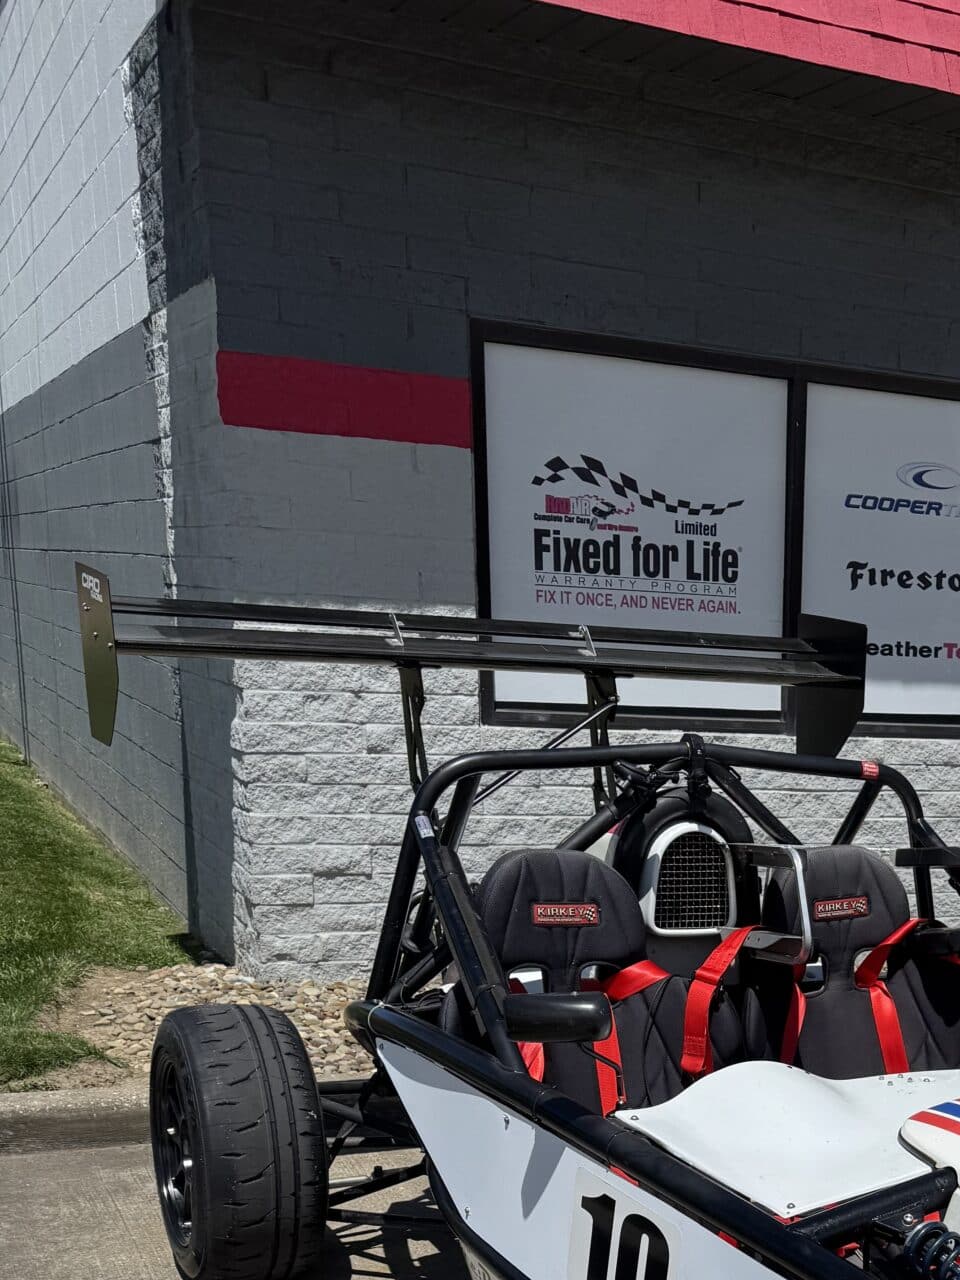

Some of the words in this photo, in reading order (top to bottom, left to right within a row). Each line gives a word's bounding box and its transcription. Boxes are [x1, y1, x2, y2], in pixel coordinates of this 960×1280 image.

[674, 519, 717, 537] Limited
[534, 528, 621, 576] Fixed
[631, 535, 679, 579] for
[686, 540, 739, 583] Life
[534, 574, 638, 589] WARRANTY
[651, 581, 737, 595] PROGRAM
[535, 589, 556, 604] FIX
[561, 591, 572, 605] IT
[576, 592, 617, 610] ONCE,
[620, 595, 648, 609] AND
[651, 596, 695, 611] NEVER
[698, 599, 741, 615] AGAIN.
[537, 907, 585, 916] KIRKEY
[818, 901, 857, 912] KIRKEY
